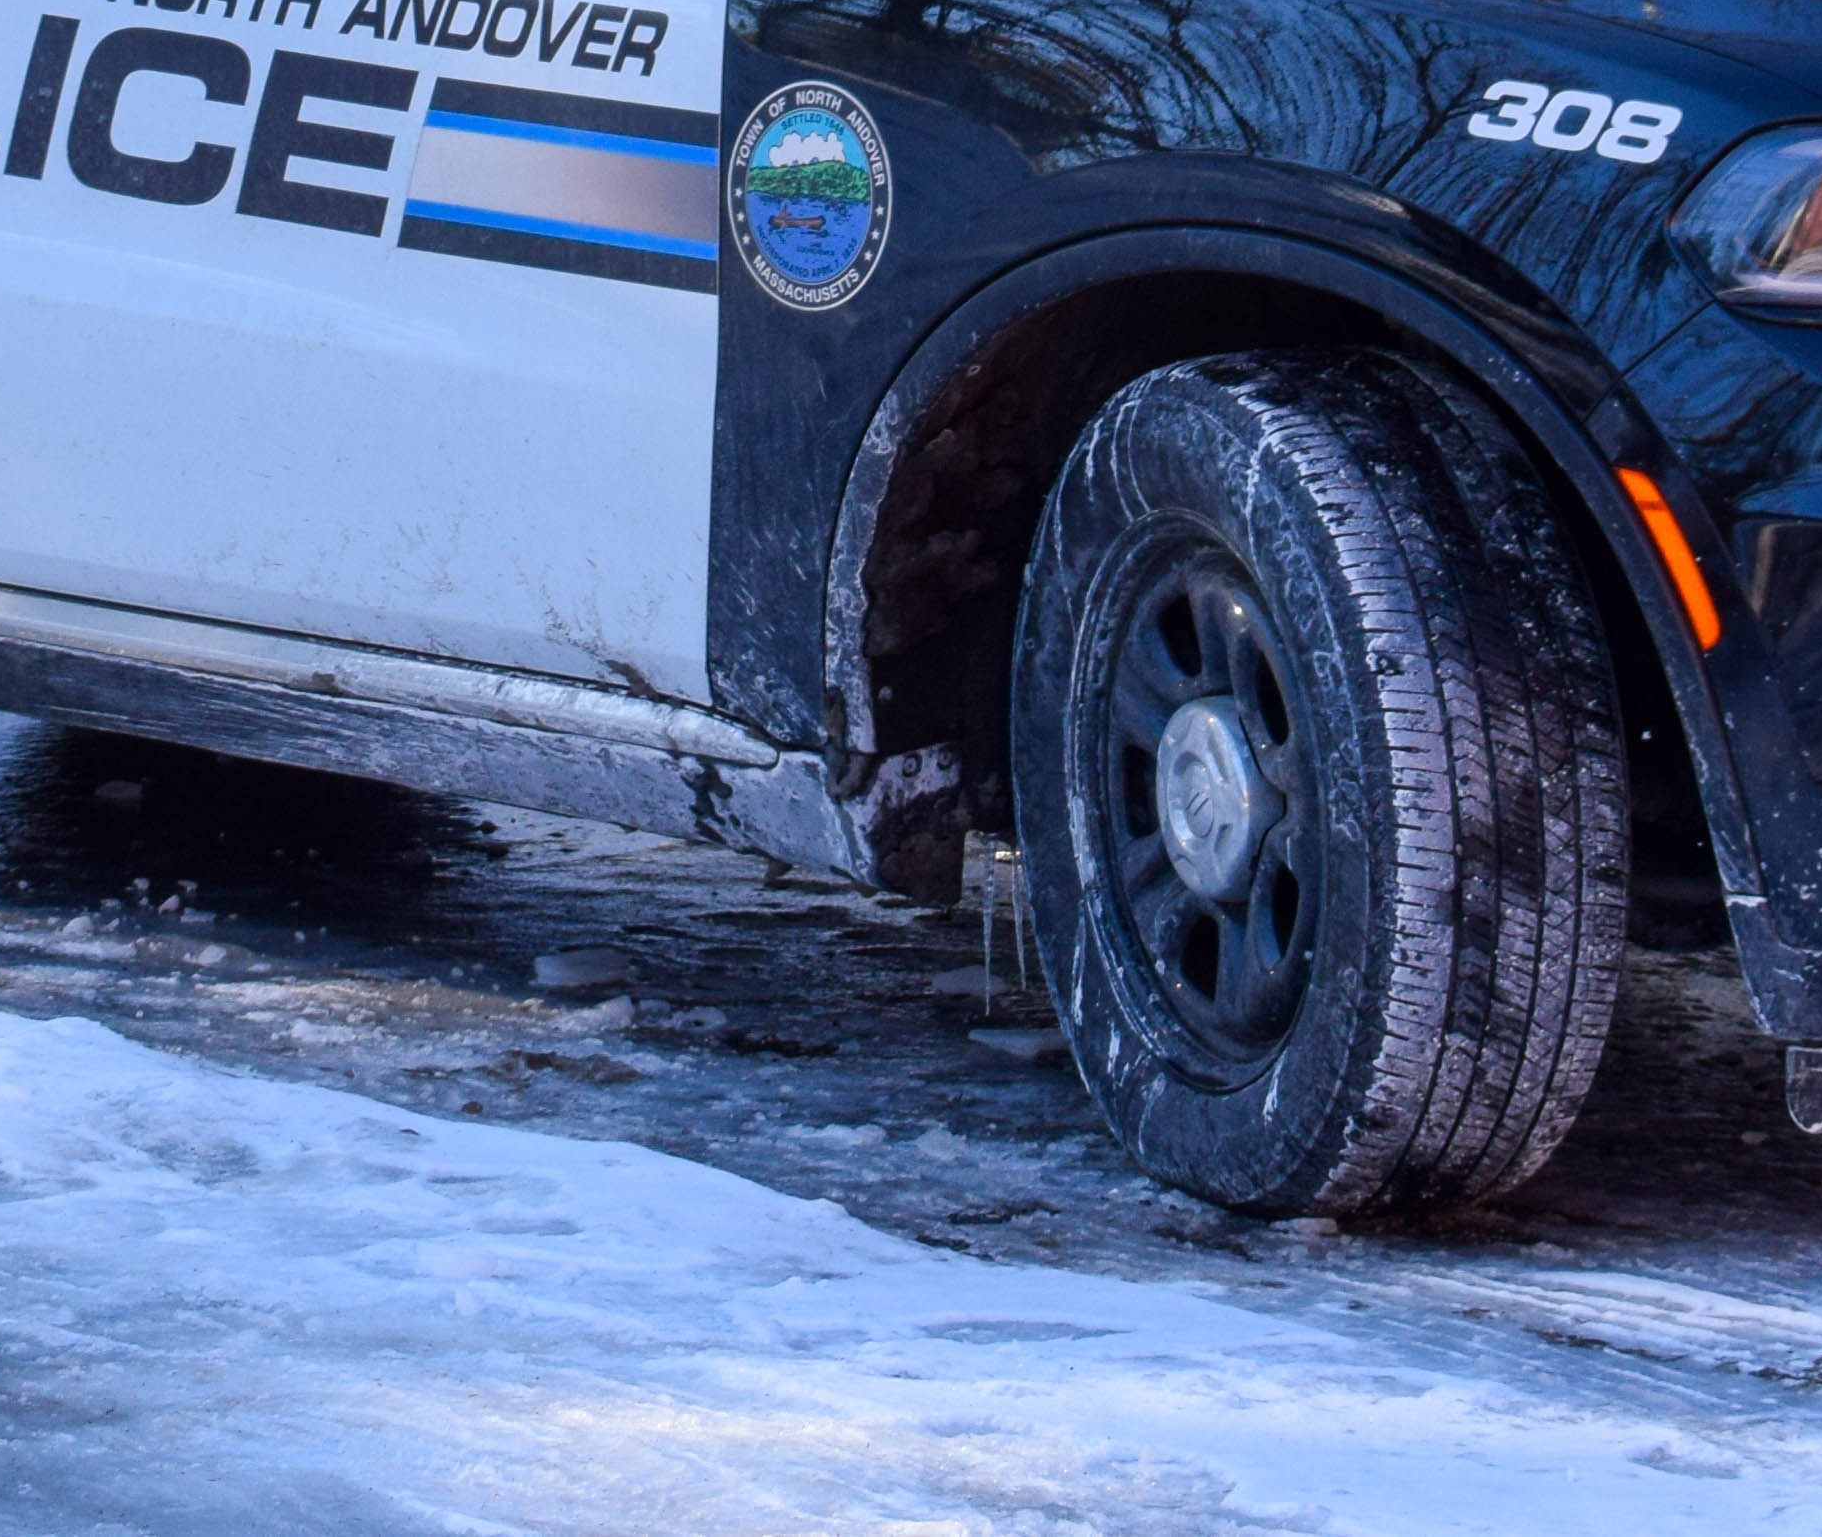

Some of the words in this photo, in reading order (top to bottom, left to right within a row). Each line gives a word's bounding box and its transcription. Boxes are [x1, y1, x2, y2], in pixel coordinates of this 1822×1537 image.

[736, 119, 764, 167] TOWN
[768, 97, 787, 118] OF
[795, 89, 842, 112] NORTH
[846, 110, 886, 187] ANDOVER
[1467, 79, 1683, 164] 308
[752, 255, 861, 303] MASSACHUSETTS
